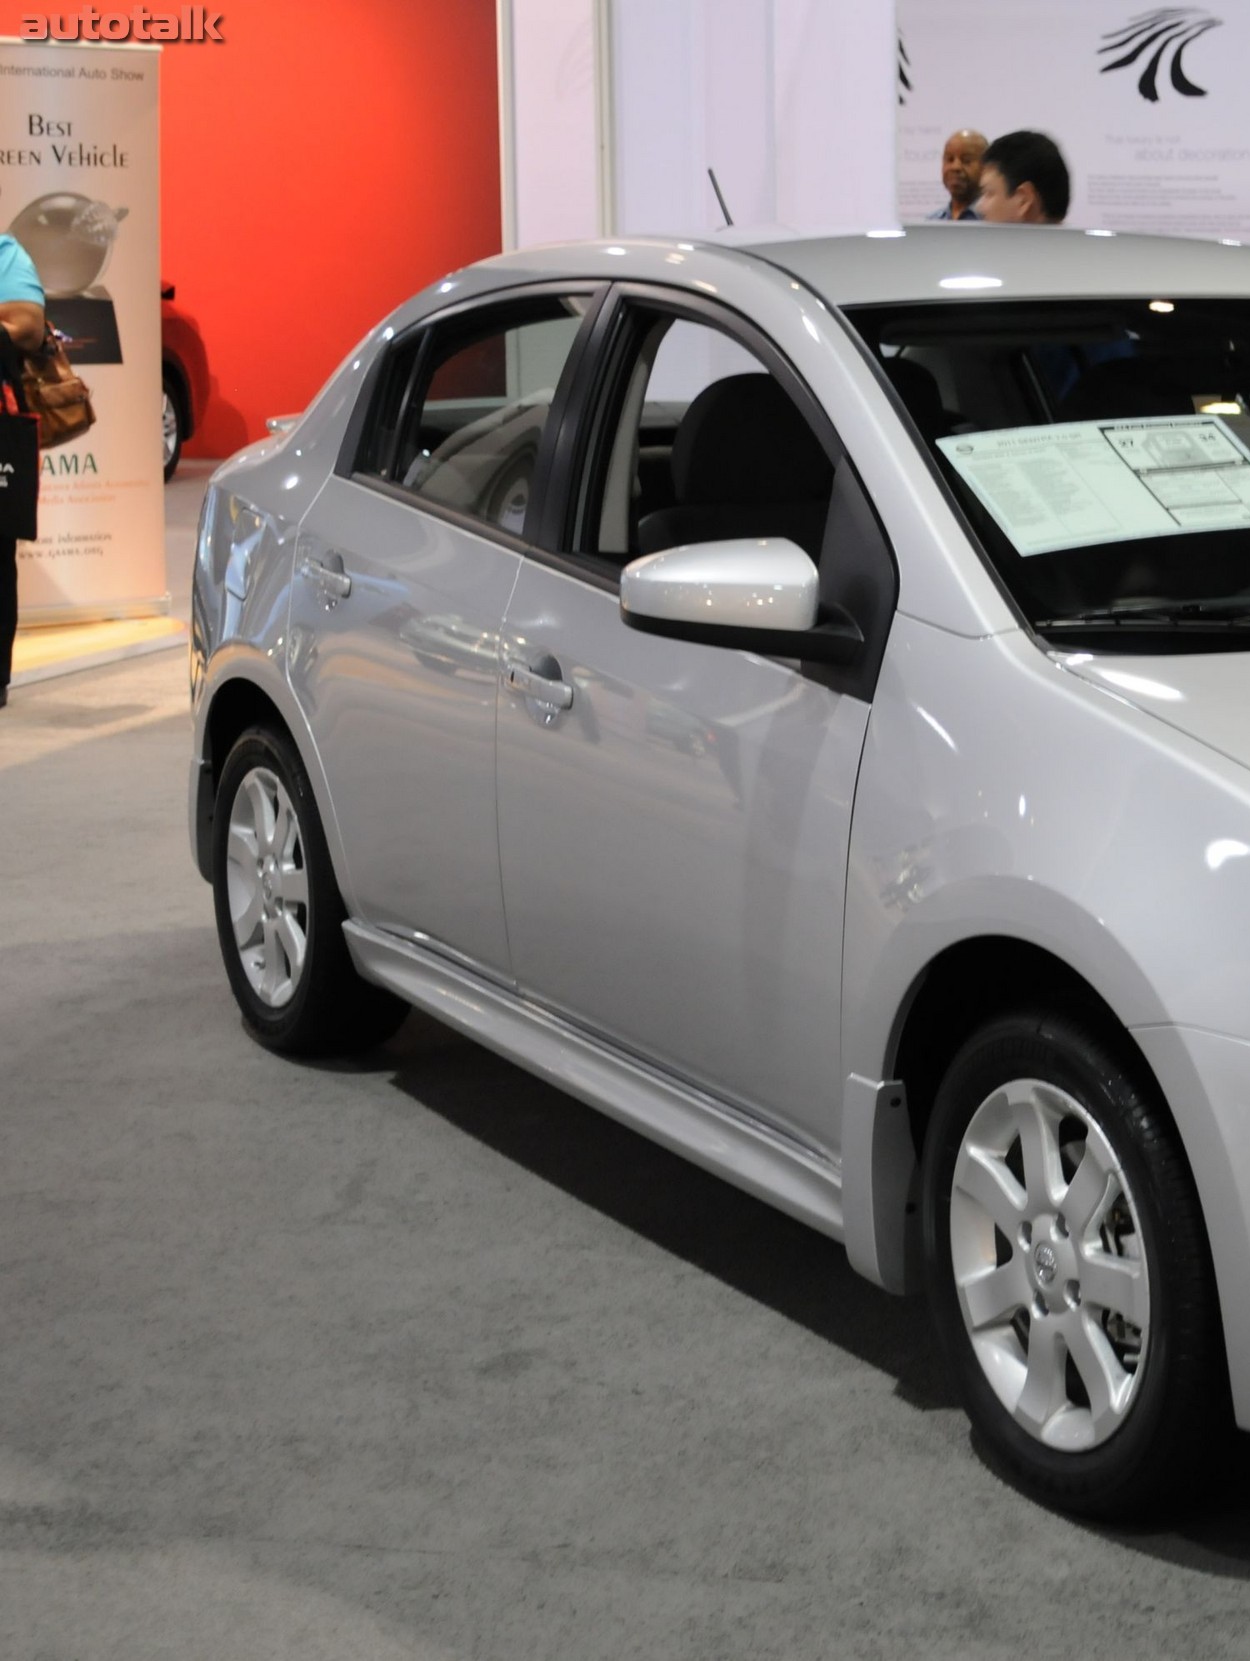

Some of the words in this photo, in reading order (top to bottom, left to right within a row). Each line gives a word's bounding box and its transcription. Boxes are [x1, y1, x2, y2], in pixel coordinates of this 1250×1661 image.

[0, 65, 75, 79] International
[79, 68, 107, 80] Auto
[111, 69, 144, 81] Show
